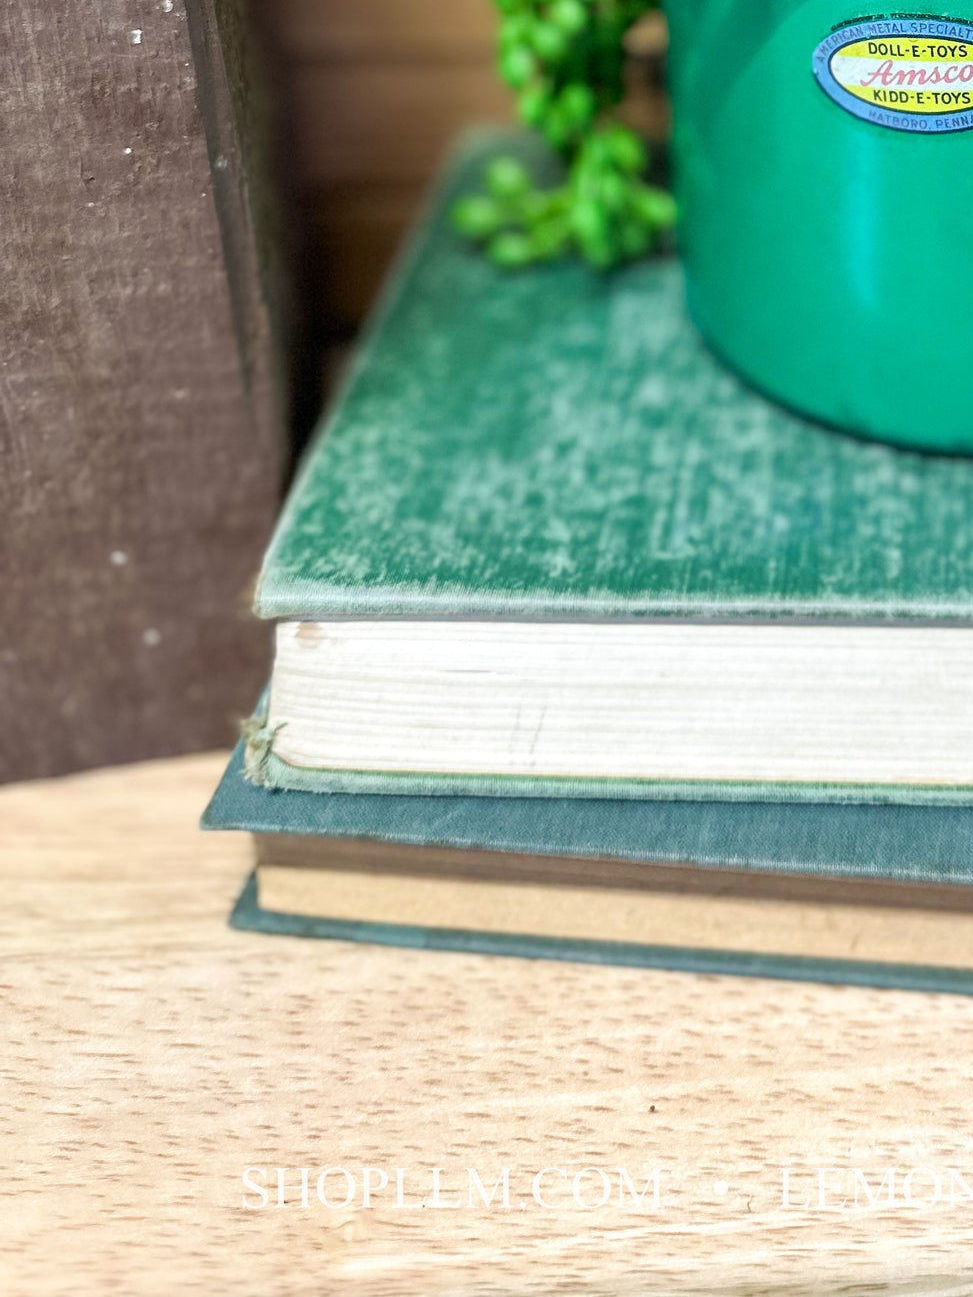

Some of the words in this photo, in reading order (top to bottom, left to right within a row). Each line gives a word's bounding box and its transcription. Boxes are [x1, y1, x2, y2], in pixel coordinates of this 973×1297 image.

[816, 27, 864, 63] AMERICAN
[868, 22, 907, 36] METAL
[868, 42, 968, 58] DOLL-E-TOYS
[873, 90, 971, 104] KIDD-E-TOYS
